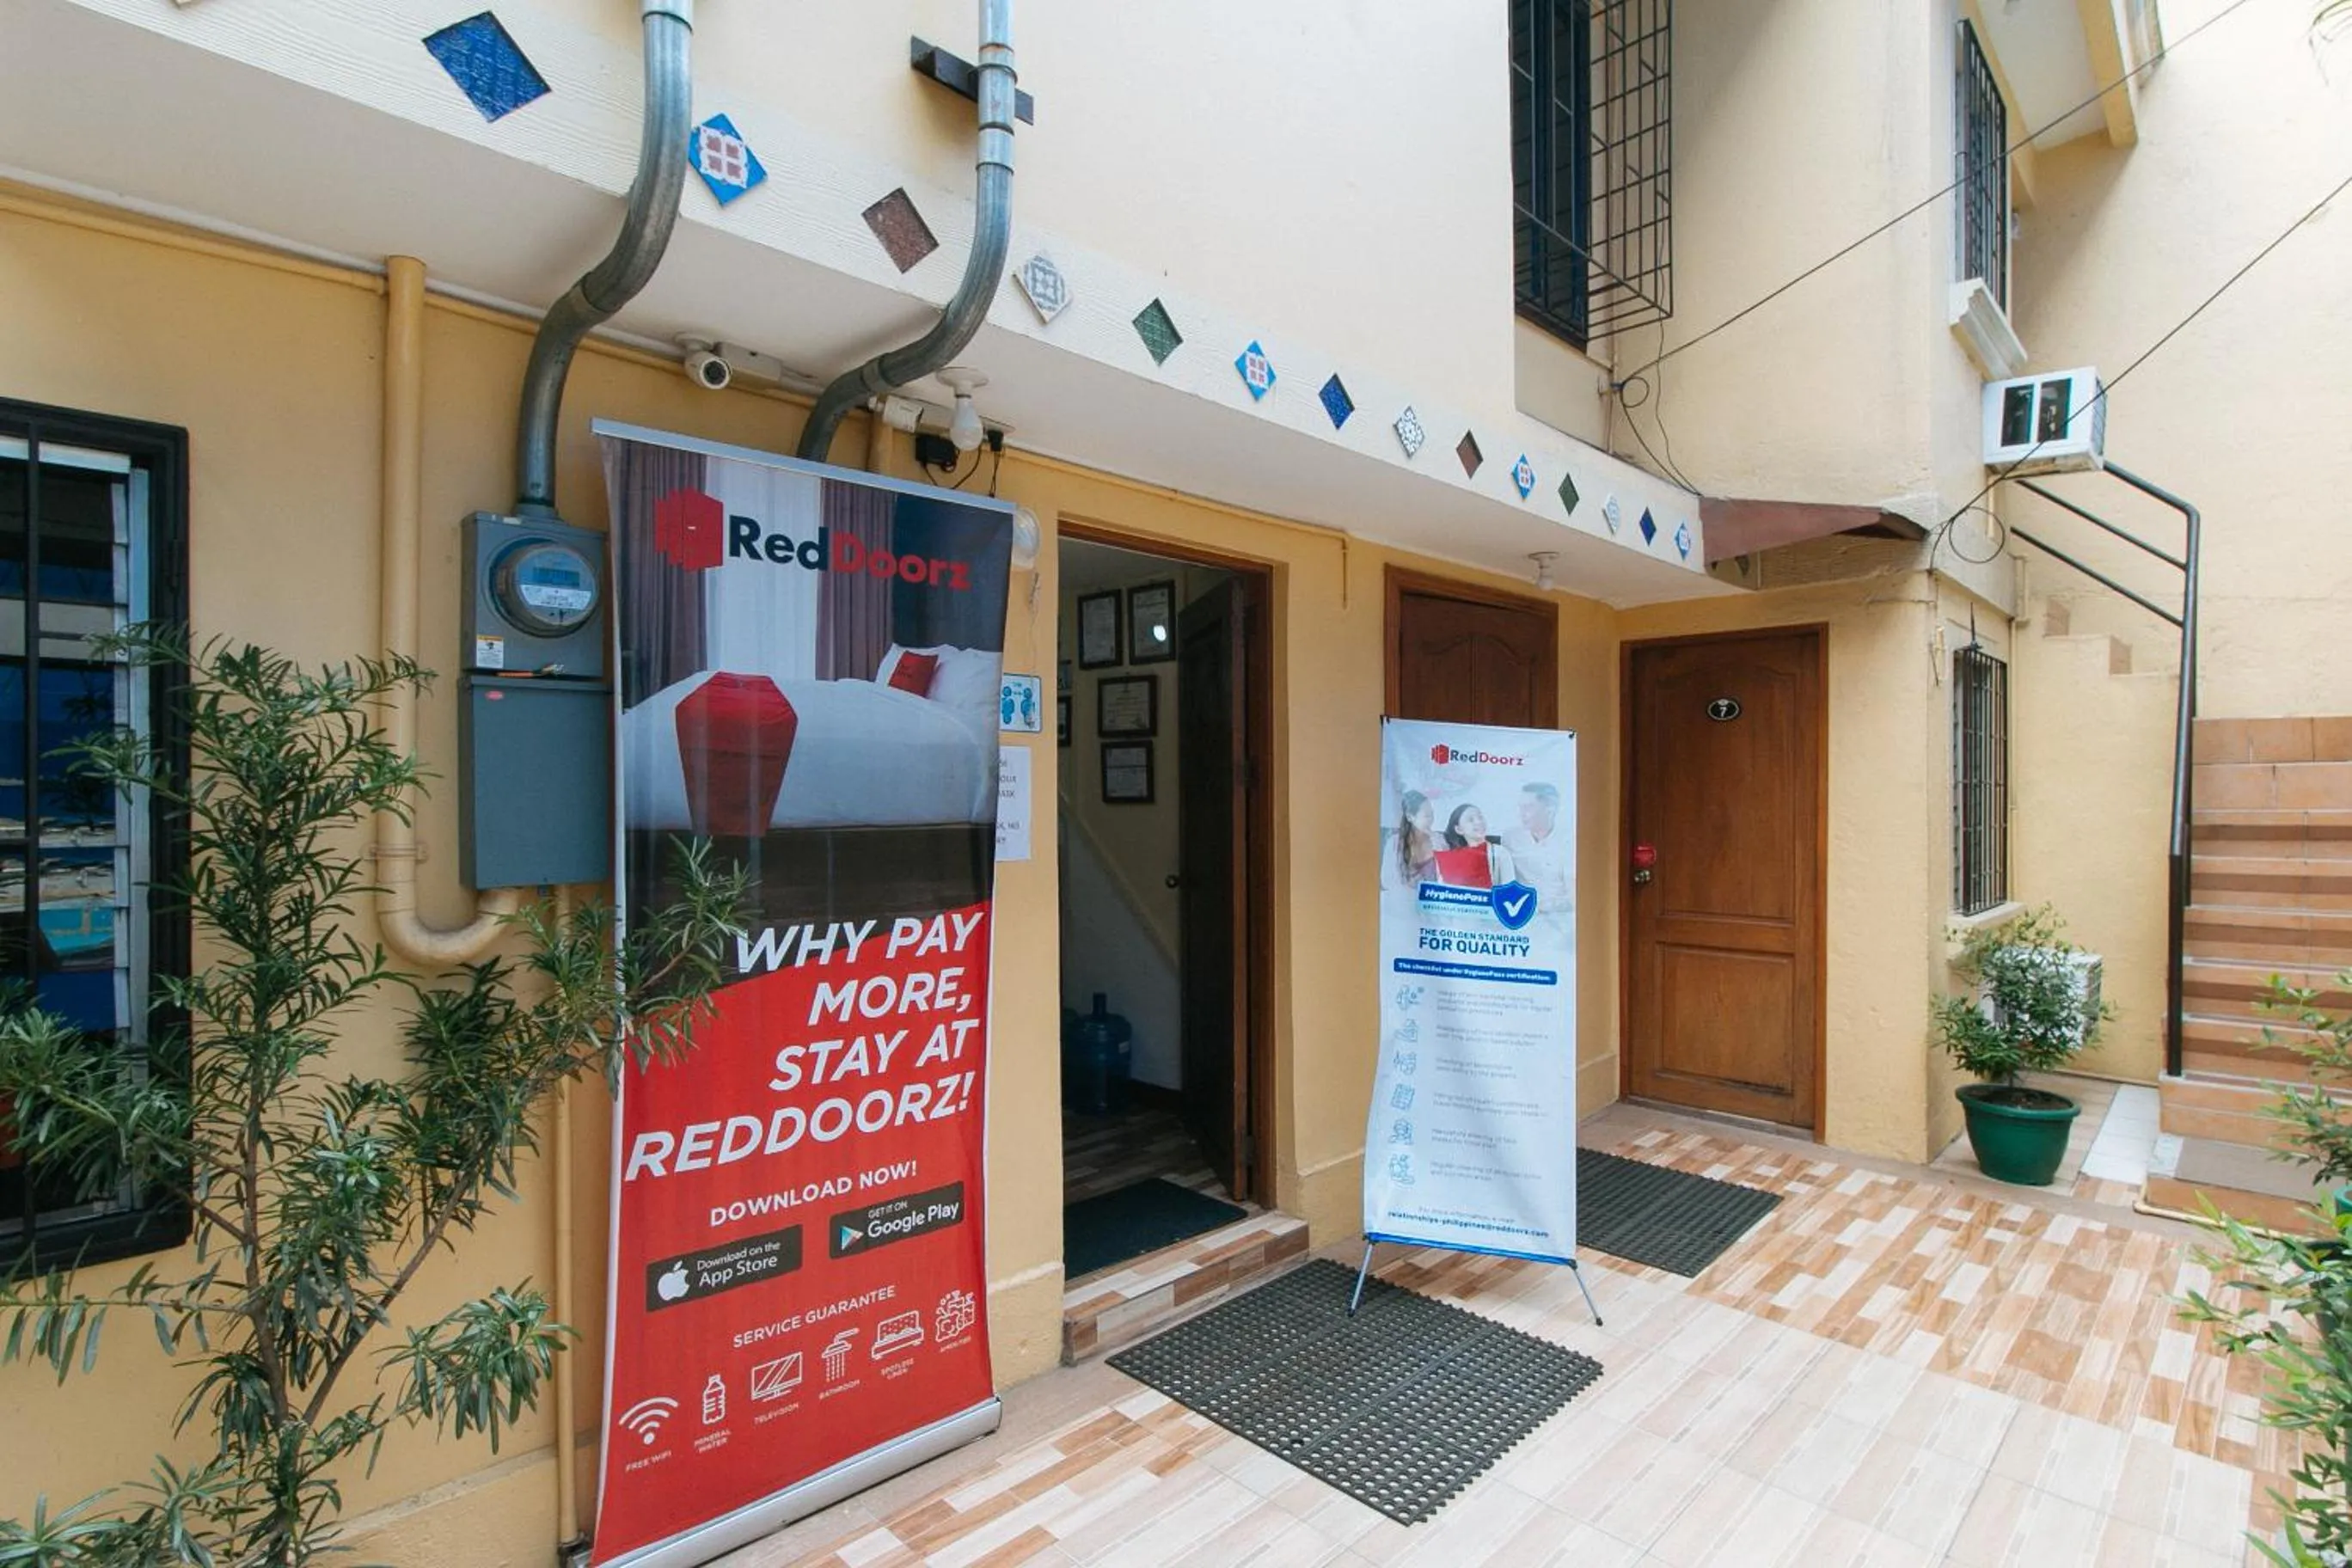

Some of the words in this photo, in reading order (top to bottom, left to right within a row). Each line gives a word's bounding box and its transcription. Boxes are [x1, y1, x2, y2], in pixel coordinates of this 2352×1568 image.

[728, 514, 972, 591] RedDoorz
[1719, 706, 1728, 718] 7
[1449, 749, 1524, 766] RedDoorz
[736, 919, 878, 974] WHY
[885, 911, 985, 959] PAY
[1418, 936, 1453, 952] FOR
[1456, 940, 1530, 957] QUALITY
[1419, 928, 1436, 937] THE
[1439, 929, 1477, 940] GOLDEN
[1479, 933, 1530, 944] STANDARD
[807, 966, 972, 1027] MORE,
[769, 1029, 908, 1092] STAY
[915, 1019, 980, 1068] AT
[624, 1070, 977, 1182] REDDOORZ!
[710, 1176, 853, 1228] DOWNLOAD
[860, 1160, 917, 1190] NOW!
[867, 1207, 885, 1219] GET
[894, 1200, 909, 1210] ON
[867, 1210, 926, 1239] Google
[928, 1202, 959, 1223] Play
[697, 1247, 748, 1271] Download
[749, 1246, 763, 1256] on
[764, 1241, 781, 1253] the
[698, 1267, 733, 1288] App
[736, 1255, 778, 1276] Store
[733, 1314, 803, 1348] SERVICE
[805, 1285, 896, 1324] GUARANTEE
[754, 1402, 799, 1424] TELEVISION
[694, 1430, 732, 1448] MINERAL
[625, 1459, 650, 1473] FREE
